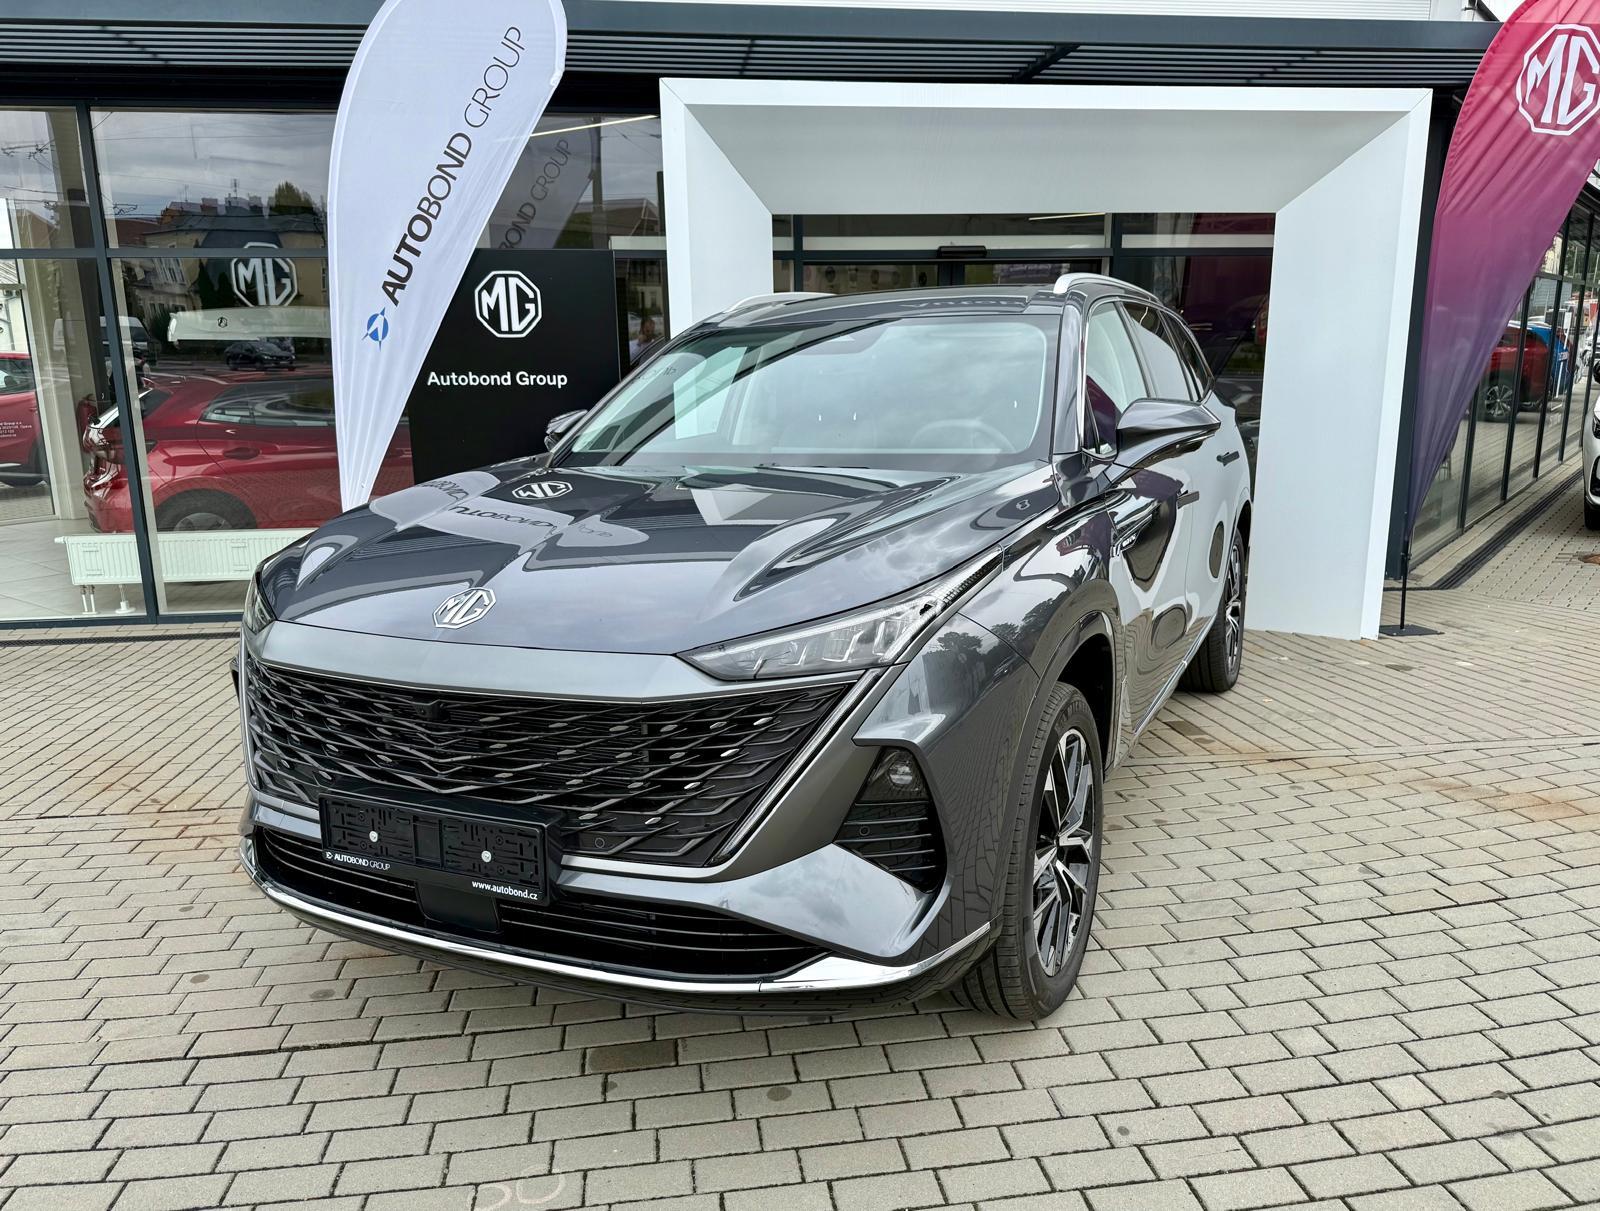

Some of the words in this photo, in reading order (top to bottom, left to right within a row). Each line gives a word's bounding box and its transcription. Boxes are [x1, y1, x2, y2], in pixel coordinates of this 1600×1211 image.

[1524, 34, 1600, 125] MG
[380, 131, 473, 307] AUTOBOND
[464, 26, 527, 128] GROUP
[236, 257, 292, 306] MG
[480, 276, 536, 332] MG
[427, 371, 511, 386] Autobond
[516, 371, 568, 388] Group
[438, 589, 490, 625] MG
[333, 854, 369, 867] AUTOBOND
[369, 860, 391, 870] GROUP
[471, 880, 539, 900] www.autobond.cz
